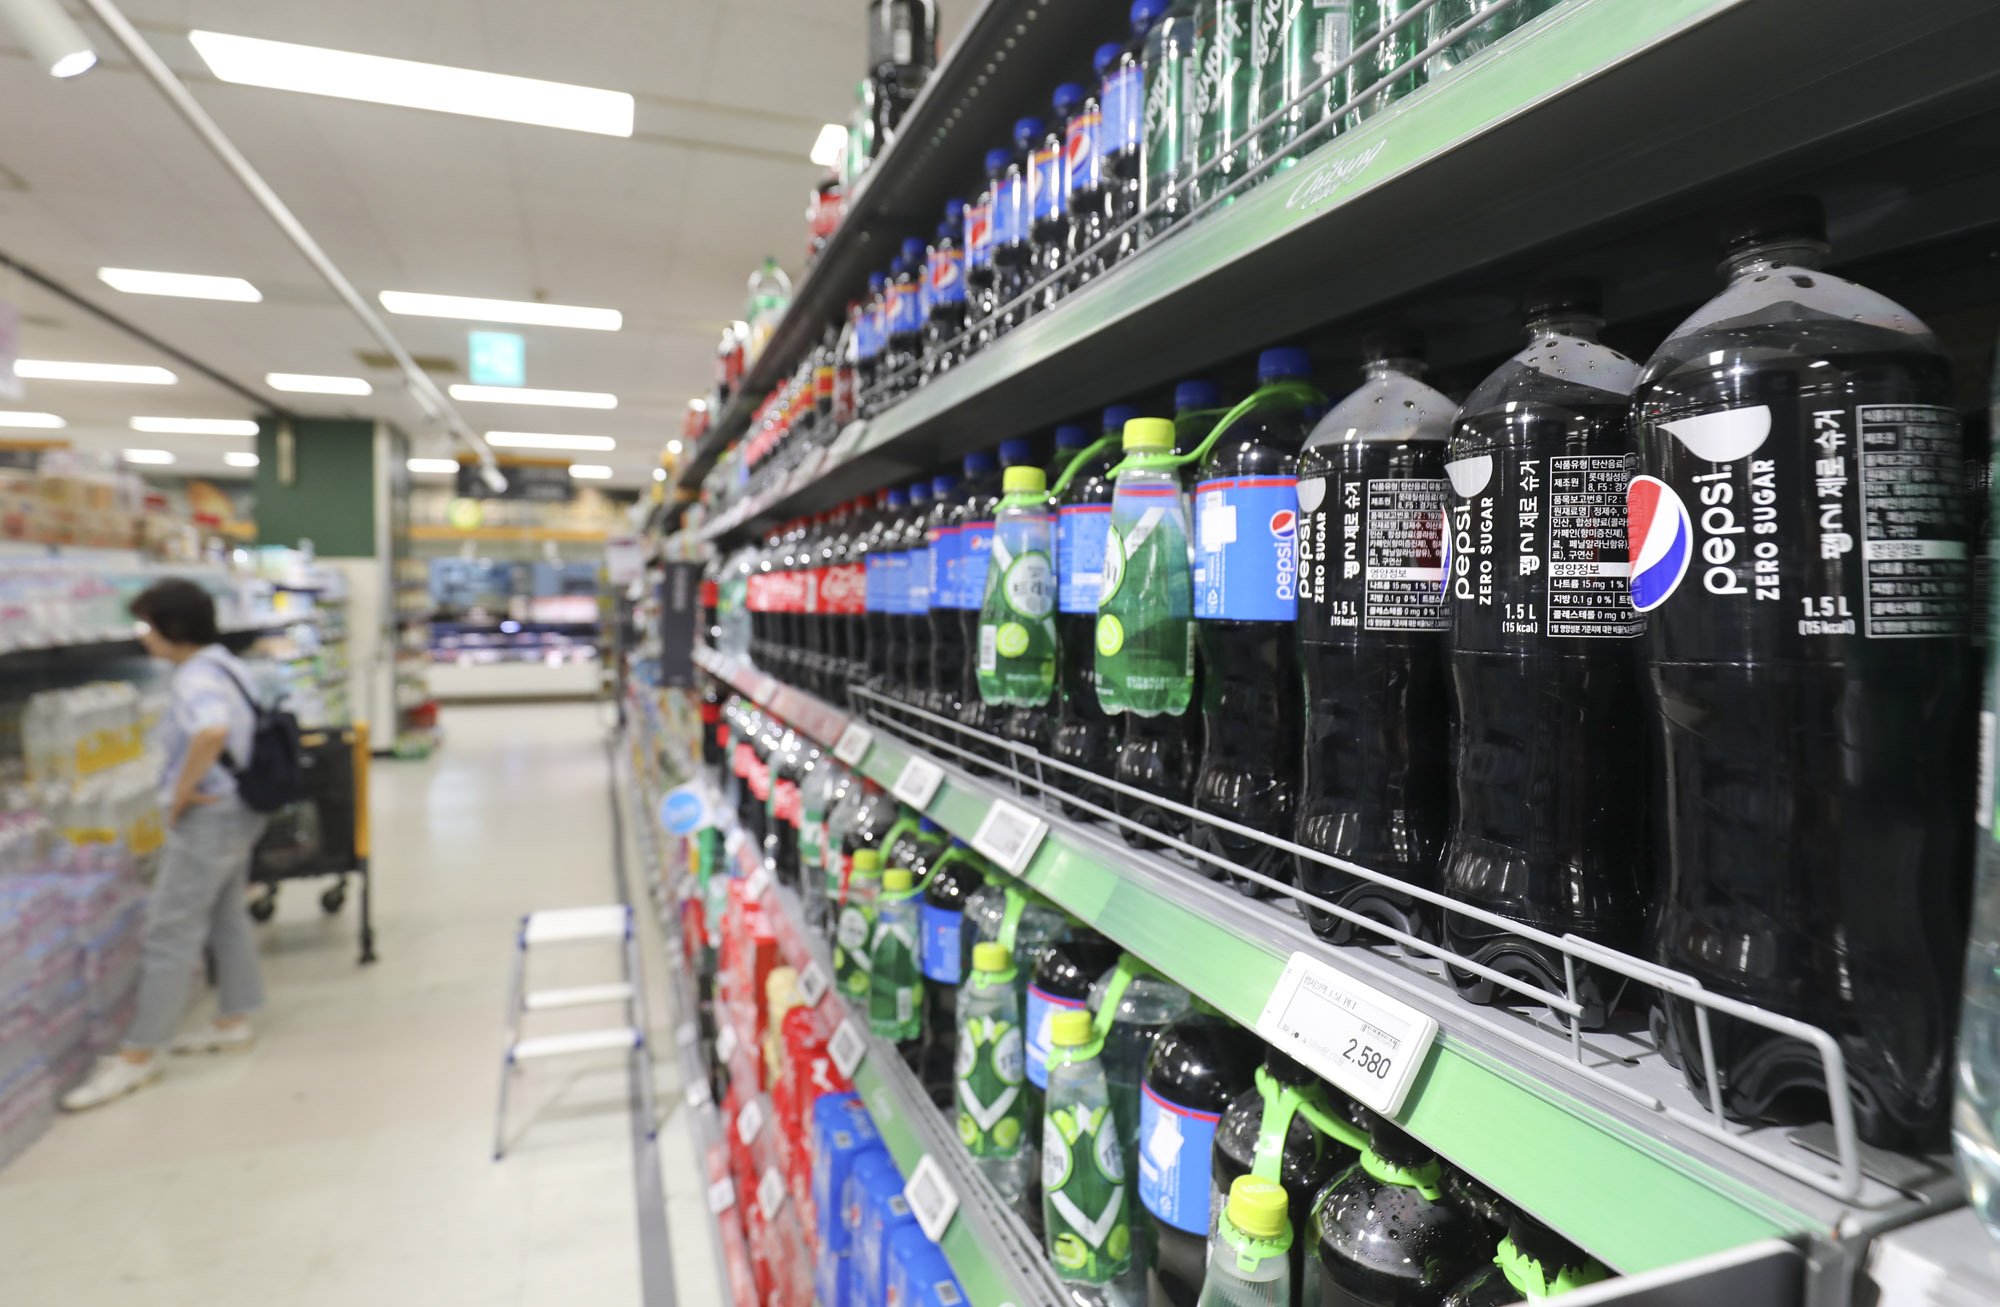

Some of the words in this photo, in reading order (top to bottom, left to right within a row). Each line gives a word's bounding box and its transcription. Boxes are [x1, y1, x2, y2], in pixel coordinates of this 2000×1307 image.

[1812, 409, 1847, 450] 슈거
[1519, 460, 1540, 491] 슈거
[1554, 460, 1587, 470] 식품유형
[1591, 460, 1623, 469] 탄산음료
[1815, 456, 1848, 497] 제로
[1344, 482, 1361, 509] 슈거
[1553, 478, 1579, 488] 제조원
[1752, 459, 1778, 534] SUGAR
[1518, 496, 1539, 528] 제로
[1553, 495, 1603, 505] 품목보고번호
[1553, 507, 1587, 516] 원재료명
[1594, 507, 1620, 516] 정제수,
[1344, 512, 1360, 539] 제로
[1480, 497, 1493, 555] SUGAR
[1552, 518, 1572, 527] 인산,
[1576, 518, 1629, 527] 합성향료(콜라
[1692, 471, 1748, 595] pepsi
[1315, 512, 1327, 562] SUGAR
[1454, 505, 1475, 600] pepsi
[1568, 550, 1594, 560] 구연산
[1273, 541, 1294, 600] pepsi
[1370, 568, 1407, 578] 영양정보
[1479, 561, 1492, 605] ZERO
[1553, 564, 1600, 575] 영양정보
[1753, 542, 1780, 600] ZERO
[1314, 565, 1325, 603] ZERO
[1553, 580, 1579, 588] 나트륨
[1582, 580, 1591, 588] 15
[1592, 581, 1605, 590] mg
[1333, 601, 1348, 615] 1.5
[1351, 601, 1357, 615] L
[1505, 604, 1525, 619] 1.5
[1529, 604, 1536, 619] L
[1553, 594, 1571, 604] 지방
[1572, 595, 1584, 603] 0.1
[1801, 596, 1835, 617] 1.5
[1838, 596, 1852, 617] L
[1502, 622, 1515, 634] (15
[1516, 622, 1538, 634] kcal)
[1553, 610, 1595, 619] 콜레스테롤
[1604, 612, 1617, 621] mg
[1343, 1038, 1392, 1080] 2,580
